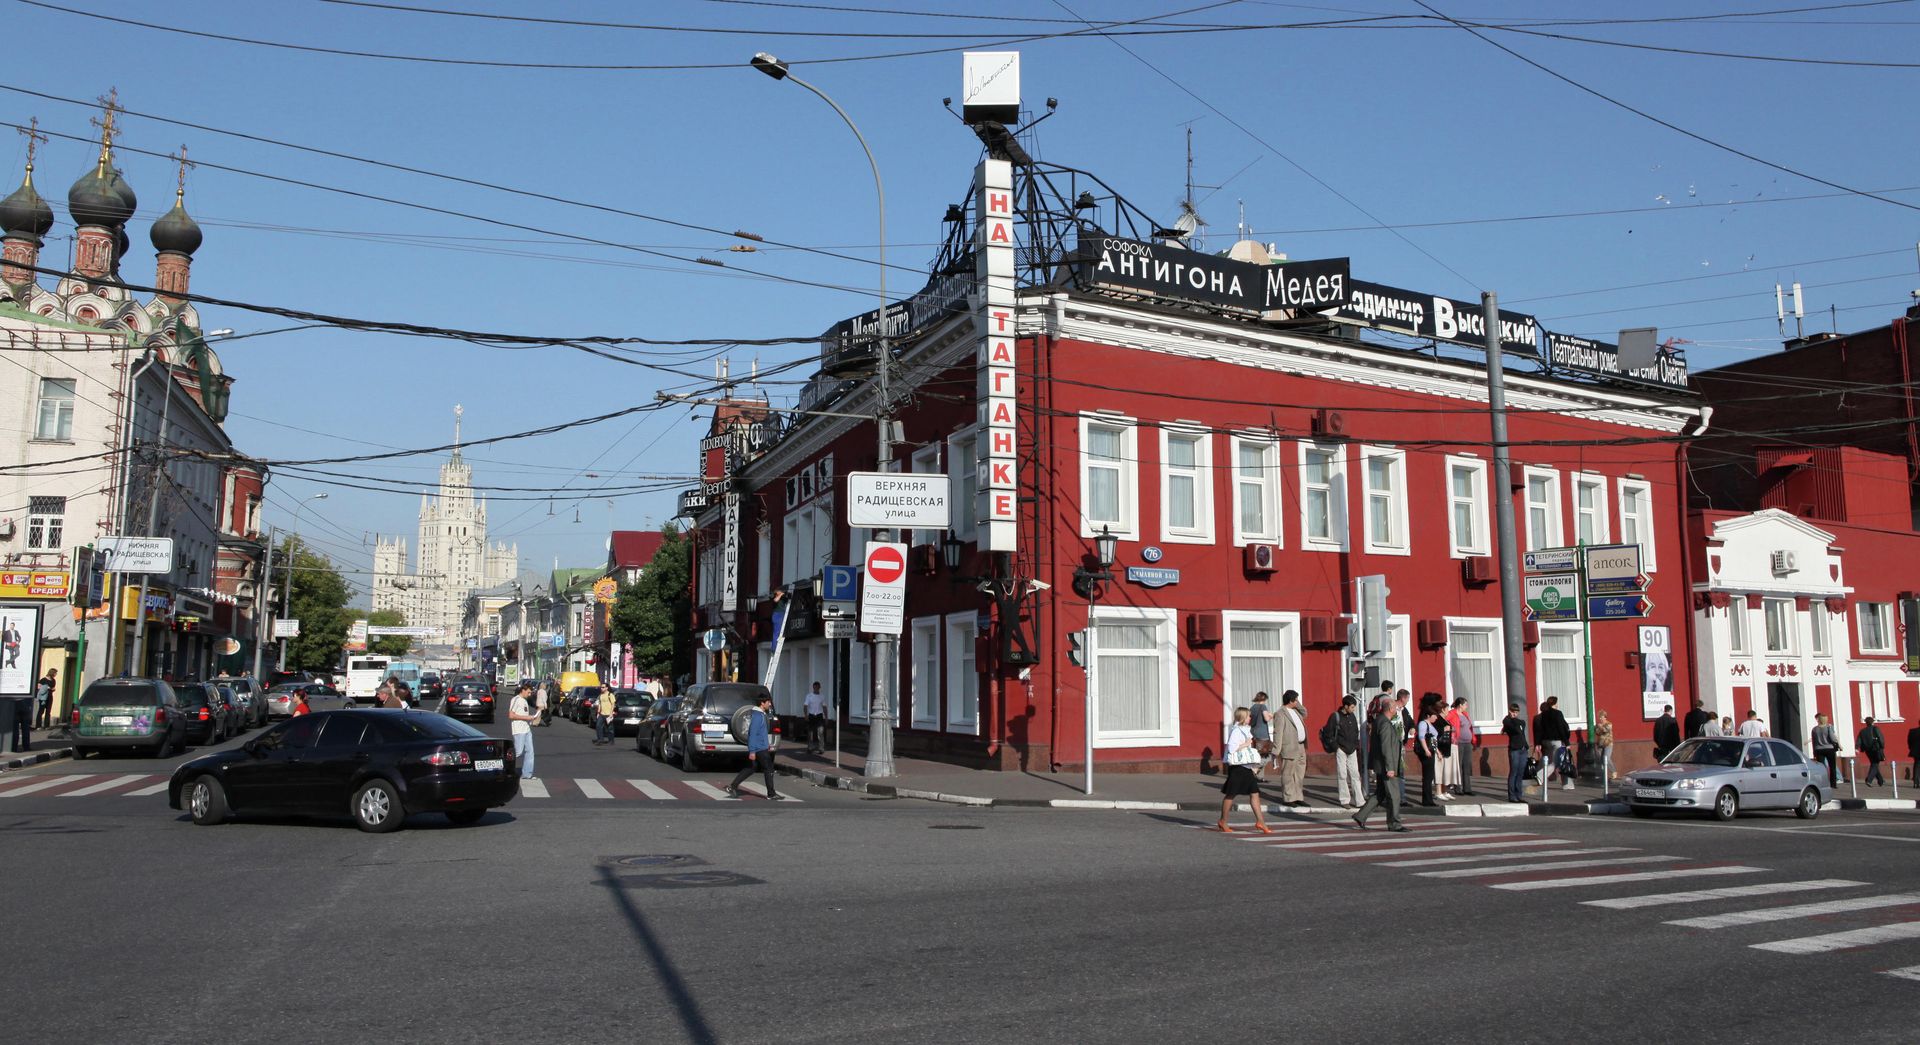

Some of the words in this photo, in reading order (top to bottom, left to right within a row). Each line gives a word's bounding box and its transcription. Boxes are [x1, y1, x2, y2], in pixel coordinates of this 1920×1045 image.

[990, 193, 1010, 244] НА
[1103, 237, 1153, 258] СОФОКЛ
[1098, 250, 1244, 297] АНТИГОНА
[1266, 267, 1344, 307] Медея
[1319, 289, 1424, 333] адимир
[1550, 335, 1599, 370] Театральный
[1600, 350, 1622, 374] рома
[1660, 355, 1688, 387] Онегин
[992, 311, 1012, 516] ТАГАНКЕ
[875, 481, 927, 492] ВЕРХНЯЯ
[857, 495, 944, 507] РАДИЩЕВСКАЯ
[884, 509, 916, 518] улица
[726, 494, 738, 594] ШАРАШКА
[1148, 549, 1158, 559] 76
[31, 587, 65, 595] КРЕДИТ
[1529, 577, 1572, 586] СТОМАТОЛОГИЯ
[1644, 629, 1663, 647] 90
